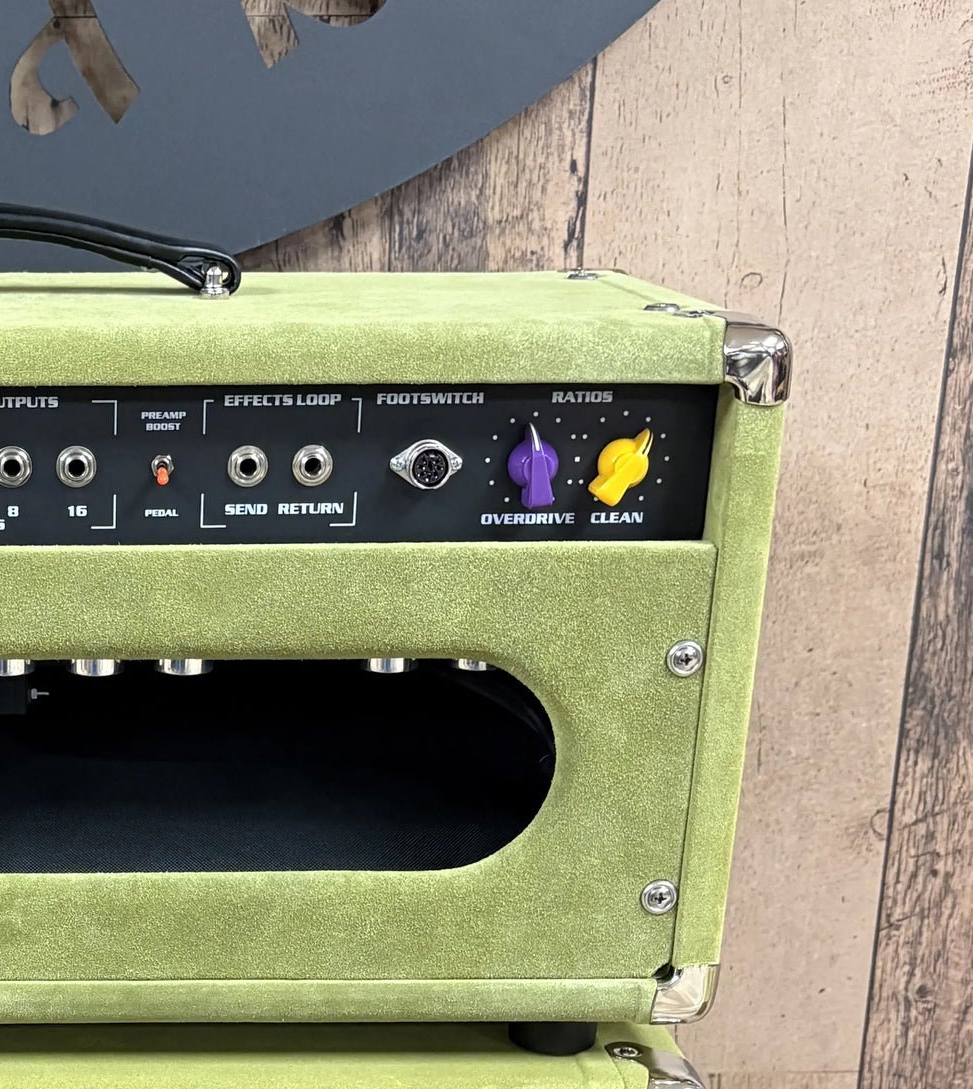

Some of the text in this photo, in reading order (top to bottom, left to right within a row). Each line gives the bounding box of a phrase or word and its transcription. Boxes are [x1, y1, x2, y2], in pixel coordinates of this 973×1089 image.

[224, 393, 342, 406] EFFECTS LOOP
[377, 392, 484, 405] FOOTSWITCH
[552, 390, 613, 403] RATIOS
[141, 411, 186, 420] PREAMP
[146, 423, 181, 431] BOOST
[7, 506, 19, 517] 8
[68, 505, 88, 517] 16
[145, 509, 179, 517] PEDAL
[225, 504, 268, 516] SEND
[278, 503, 344, 515] RETURN
[481, 512, 575, 525] OVERDRIVE
[590, 512, 643, 524] CLEAN
